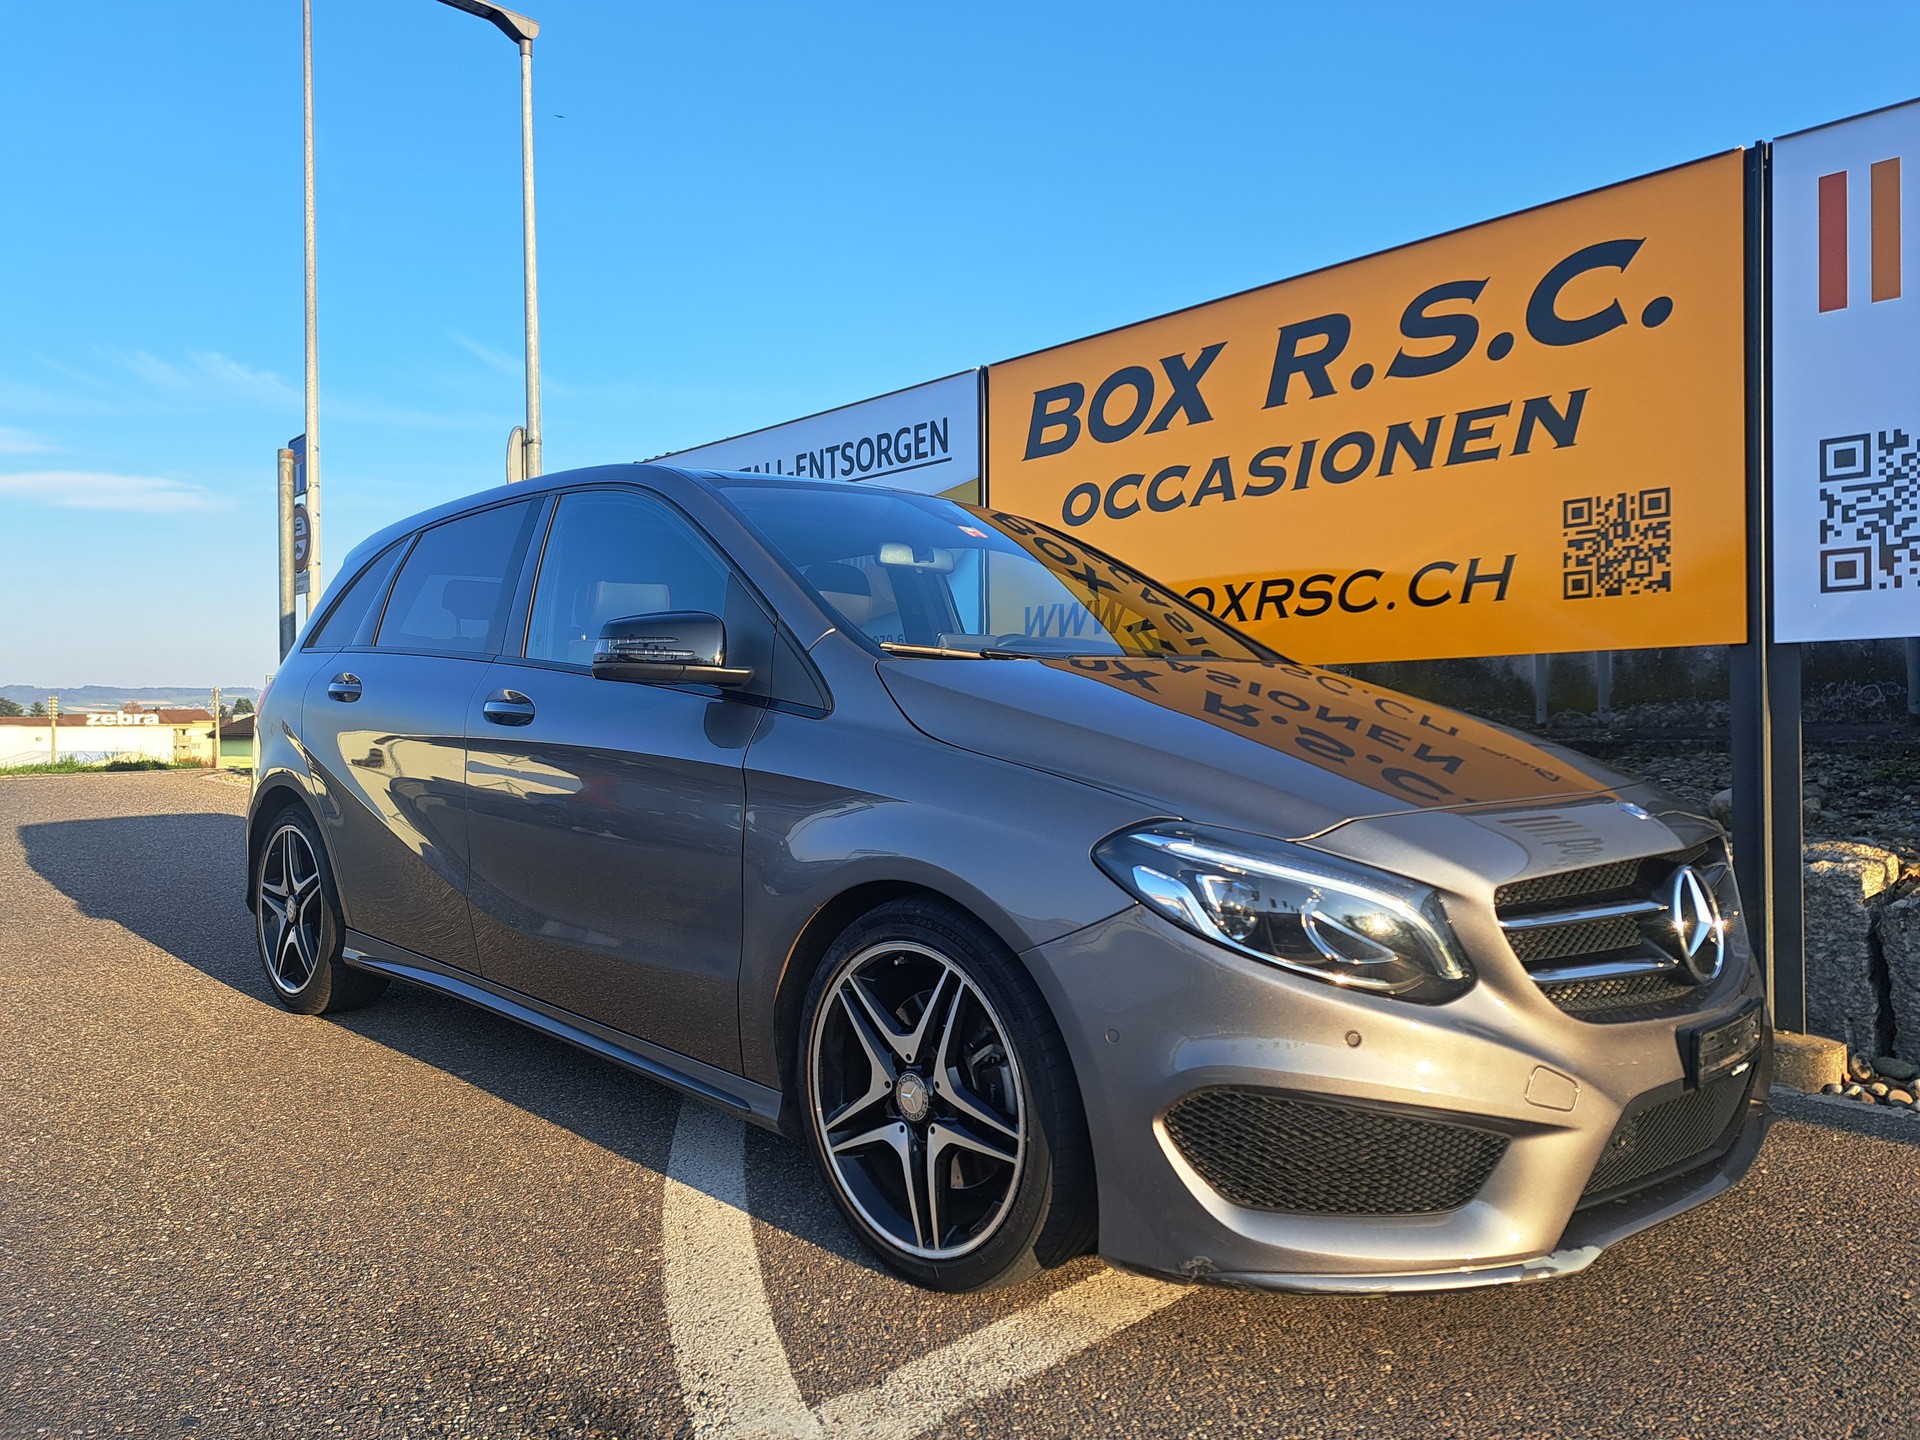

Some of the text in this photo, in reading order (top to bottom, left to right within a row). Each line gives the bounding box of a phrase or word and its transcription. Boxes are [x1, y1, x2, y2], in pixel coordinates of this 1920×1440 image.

[1022, 237, 1674, 461] BOX R.S.C.
[1062, 388, 1591, 527] OCCASIONEN
[1184, 555, 1516, 624] OXRSC.CH
[86, 709, 160, 726] zebra
